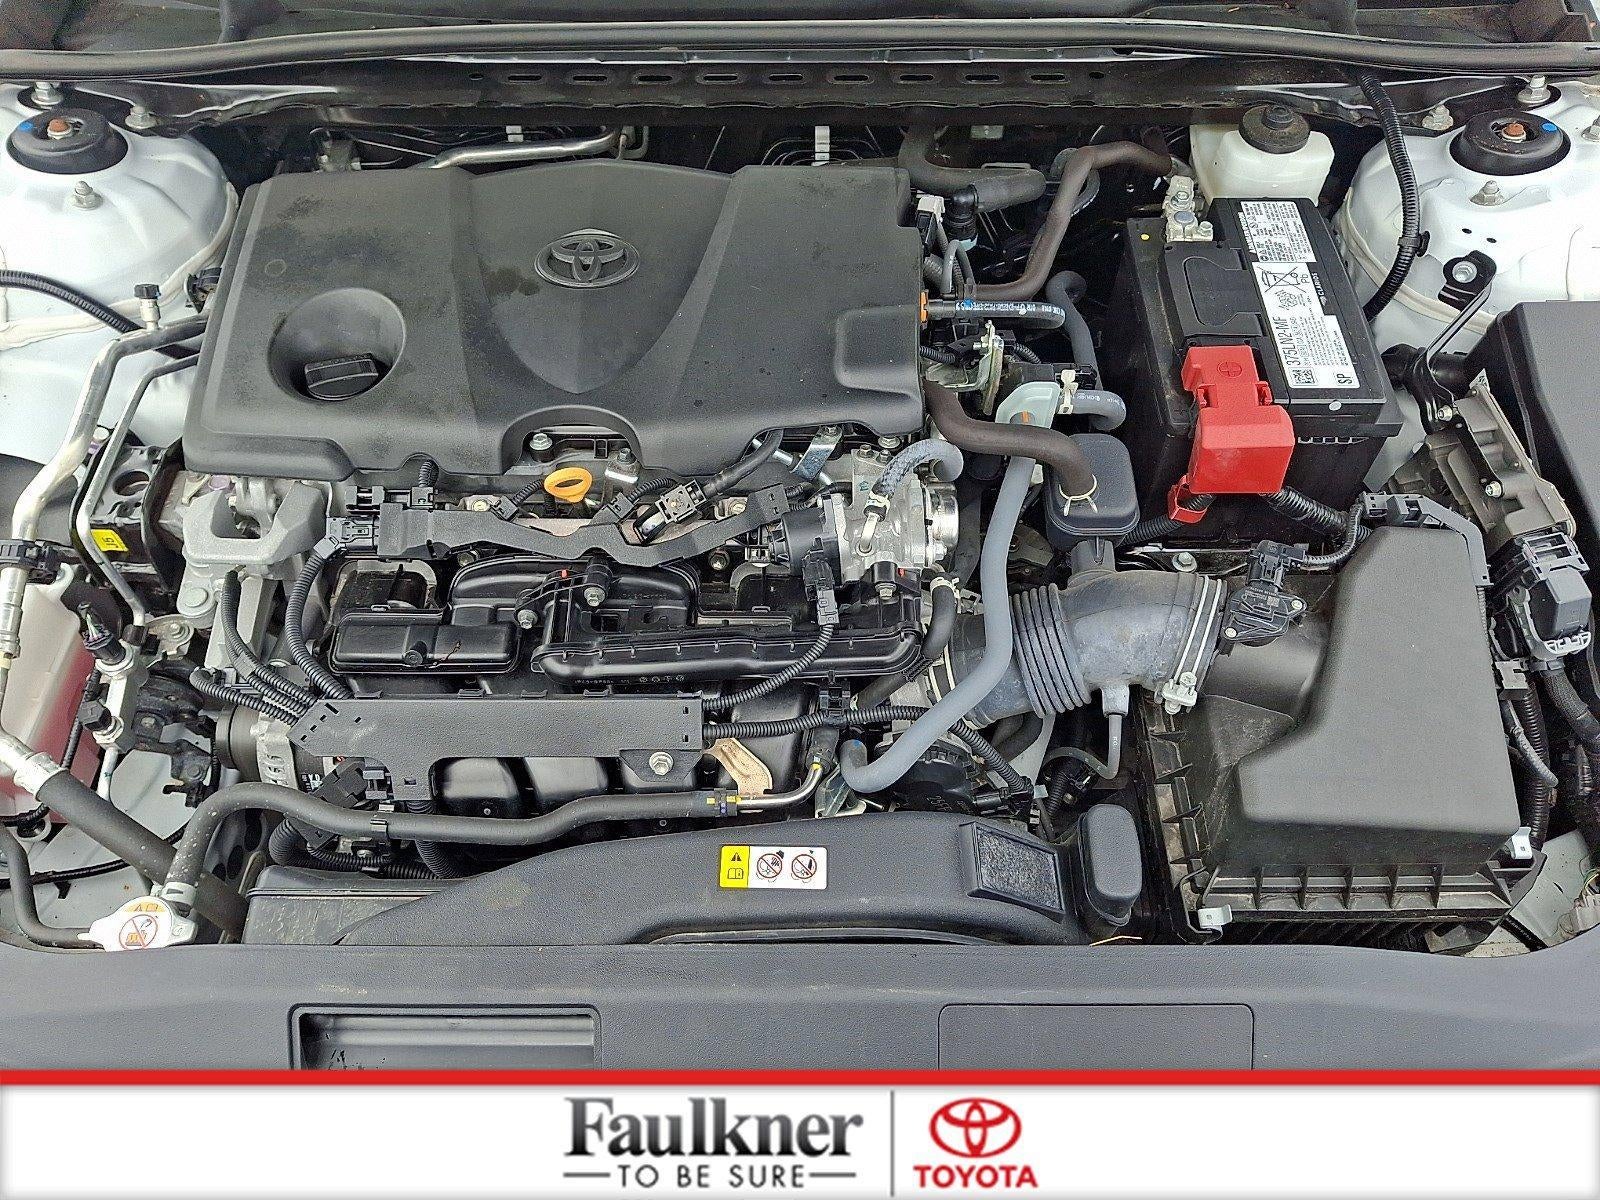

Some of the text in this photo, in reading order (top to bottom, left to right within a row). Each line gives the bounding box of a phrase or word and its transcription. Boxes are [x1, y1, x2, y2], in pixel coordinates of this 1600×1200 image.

[1300, 273, 1310, 284] Pb
[1311, 272, 1325, 296] CLARIOS
[1273, 316, 1300, 366] 375LN2-MF
[1336, 373, 1353, 385] SP
